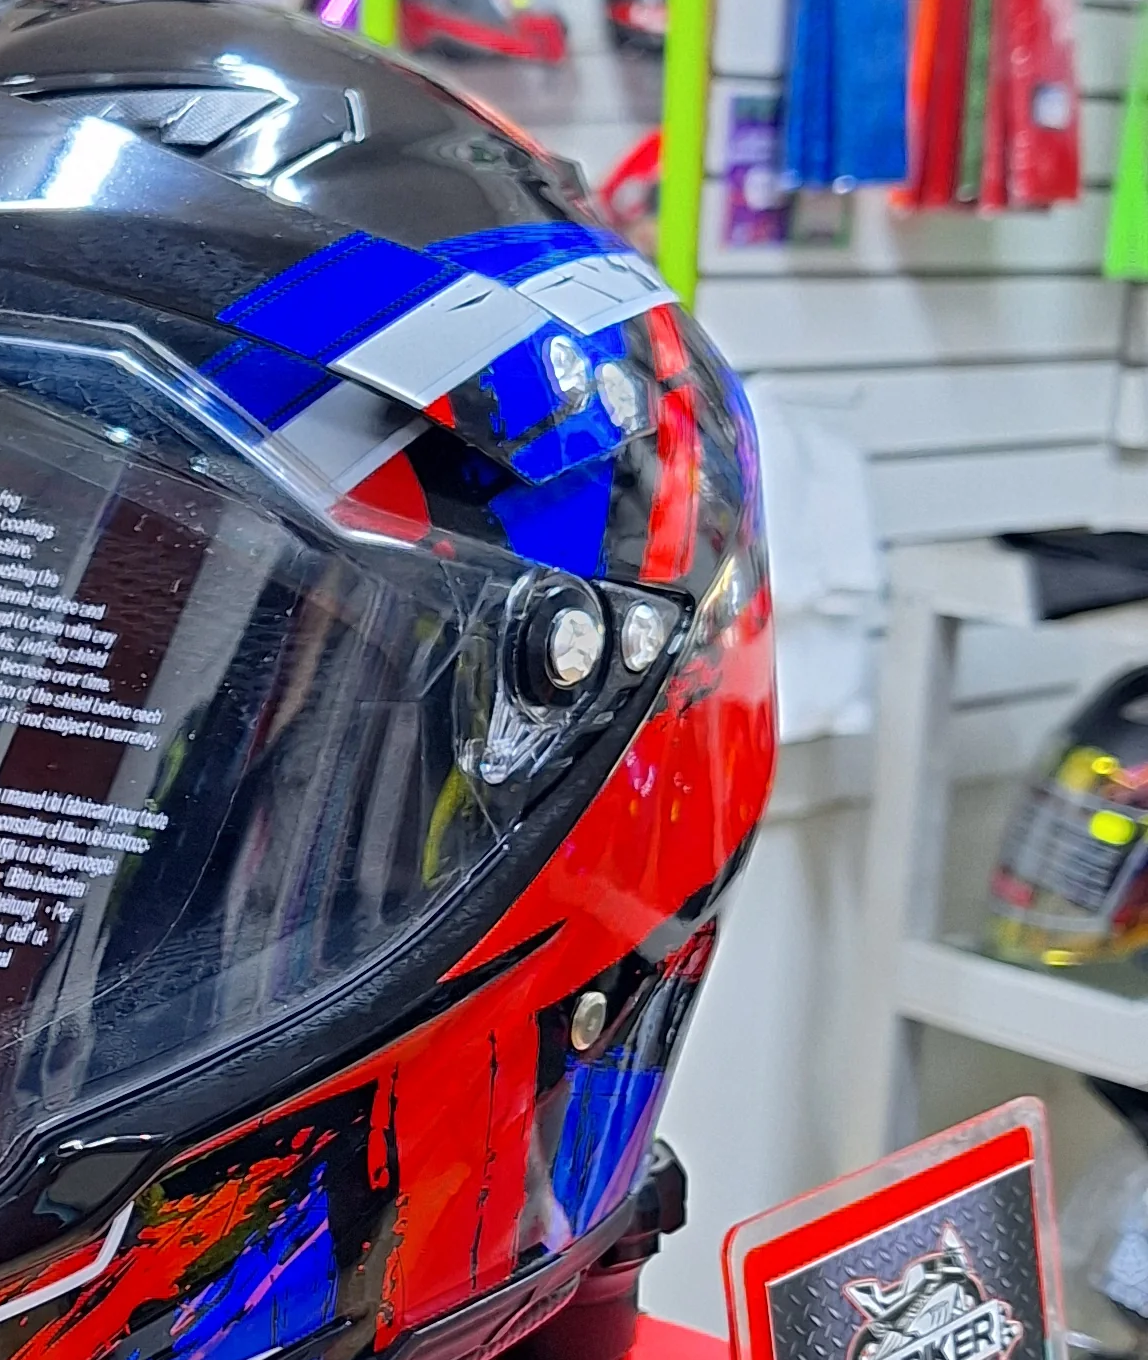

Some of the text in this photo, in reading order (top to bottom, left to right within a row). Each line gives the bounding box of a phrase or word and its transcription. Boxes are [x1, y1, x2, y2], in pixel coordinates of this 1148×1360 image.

[0, 517, 55, 541] coatings
[31, 594, 79, 615] surface
[28, 616, 65, 636] clean
[64, 623, 93, 641] with
[17, 637, 69, 664] Anti-fog
[67, 647, 109, 668] shield
[51, 670, 83, 687] over
[80, 672, 110, 693] time.
[53, 692, 94, 713] shield
[91, 698, 133, 720] before
[132, 708, 166, 725] each
[42, 716, 91, 737] subject
[104, 727, 162, 751] warranty.
